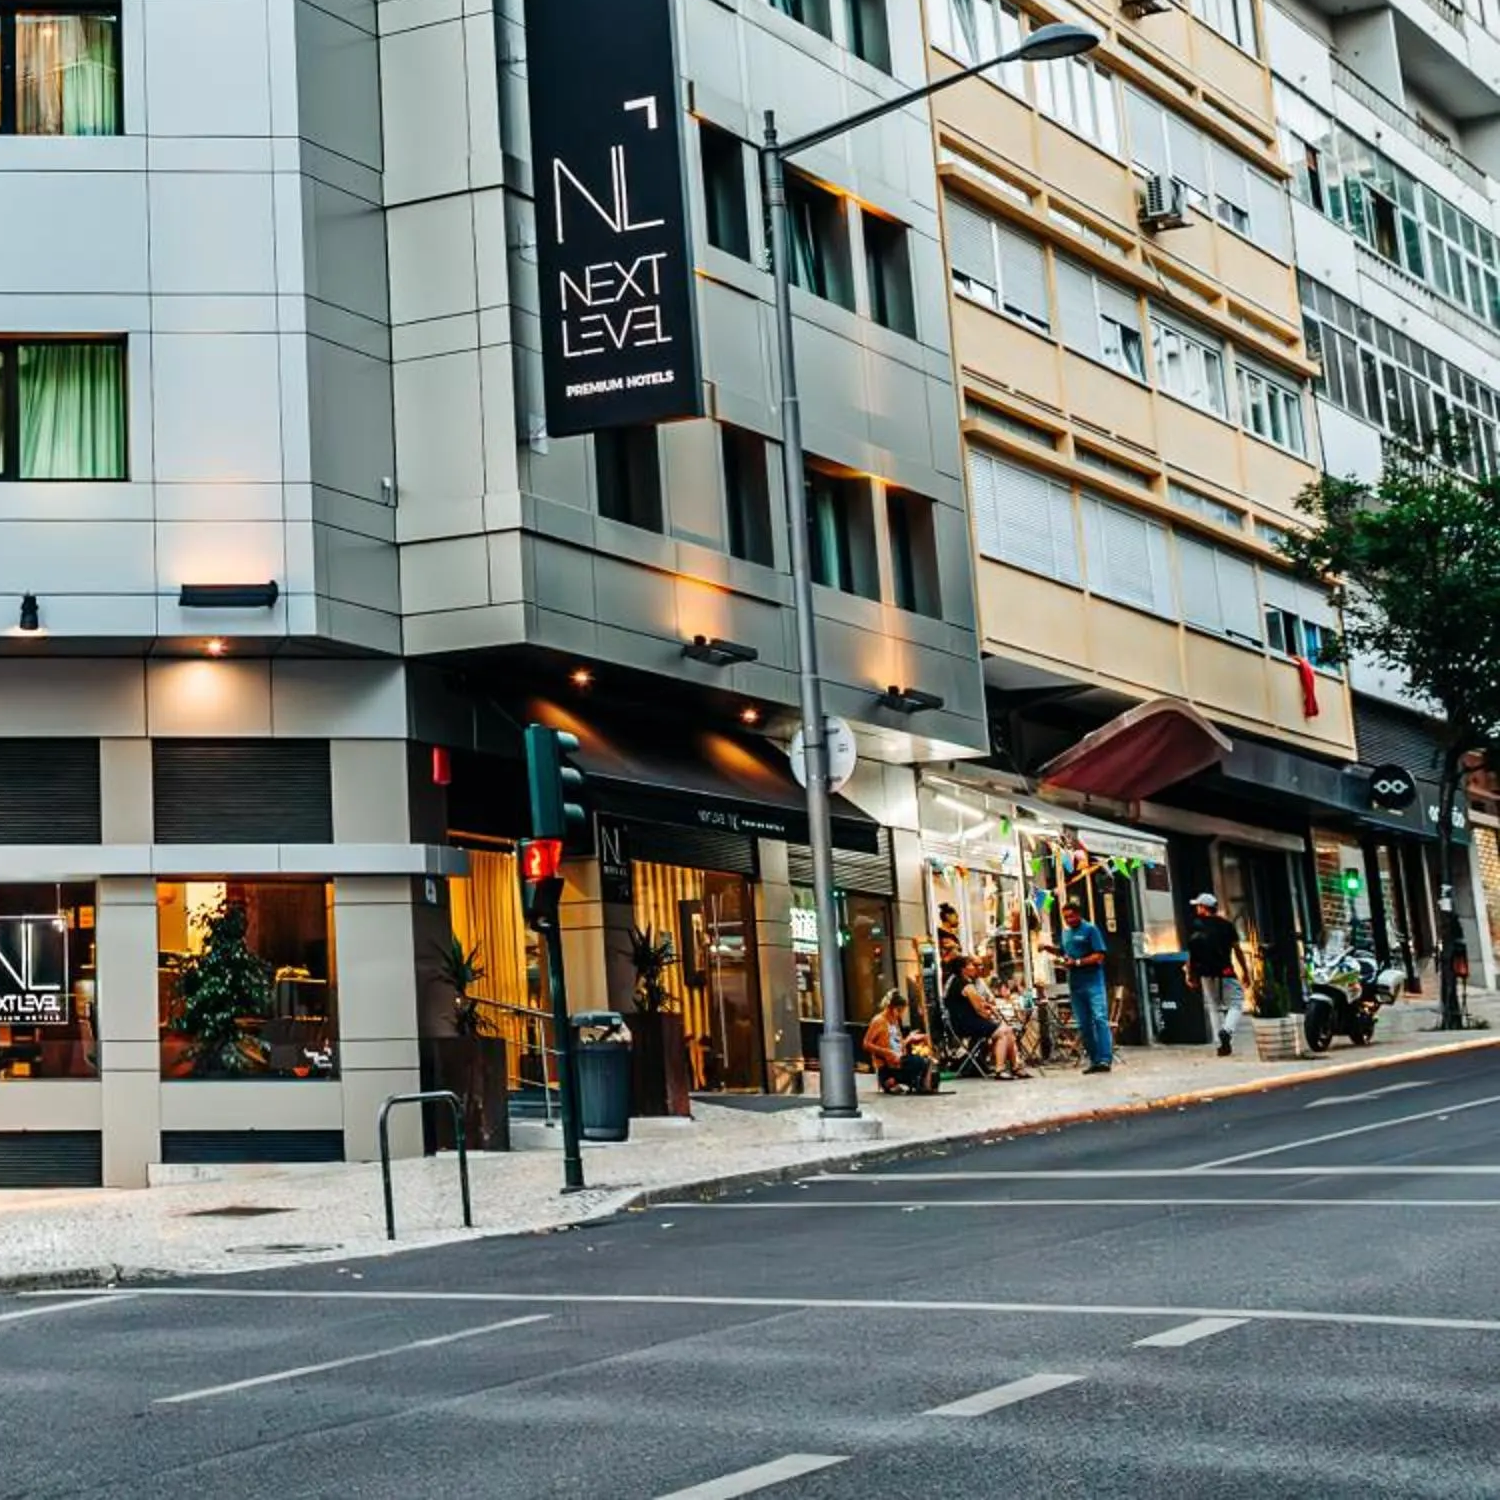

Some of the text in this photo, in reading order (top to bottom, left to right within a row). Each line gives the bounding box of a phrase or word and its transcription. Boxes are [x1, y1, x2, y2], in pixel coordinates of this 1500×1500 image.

[553, 144, 665, 244] NL
[560, 252, 668, 311] NEXT
[562, 304, 673, 357] LEVEL
[566, 369, 675, 398] PREMIUM HOTELS
[17, 994, 61, 1012] LEVEL
